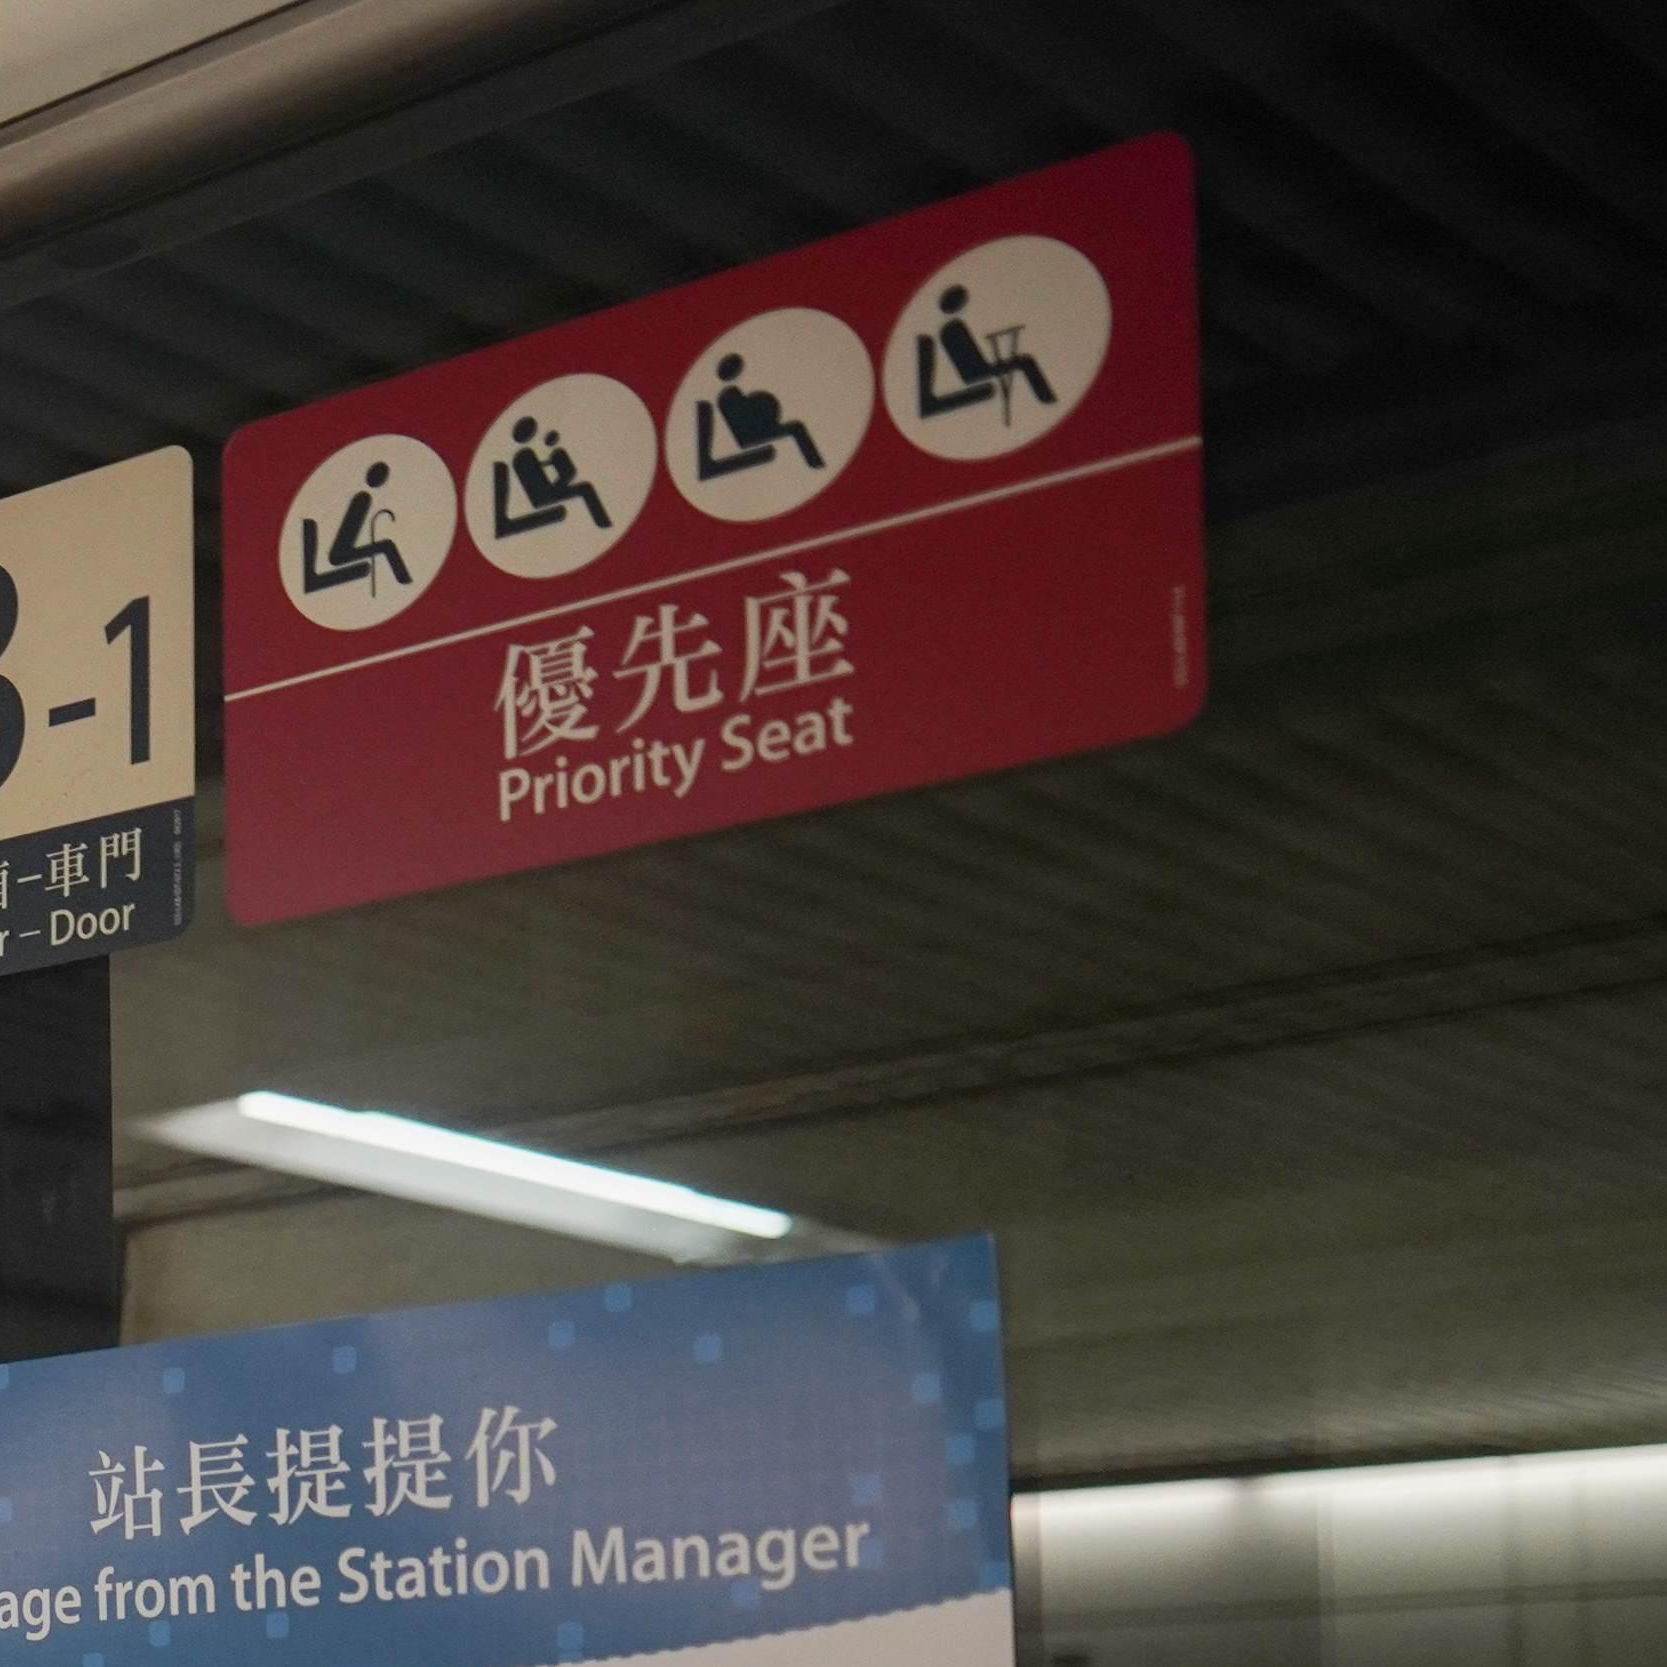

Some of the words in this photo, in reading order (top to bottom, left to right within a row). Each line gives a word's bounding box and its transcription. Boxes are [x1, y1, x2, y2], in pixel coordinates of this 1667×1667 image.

[495, 568, 855, 760] 優先座
[499, 738, 706, 822] Priority
[720, 697, 854, 772] Seat
[49, 903, 136, 946] Door
[88, 1404, 559, 1540] 站長提提你
[95, 1564, 221, 1620] from
[231, 1558, 322, 1608] the
[336, 1534, 556, 1598] Station
[571, 1520, 870, 1592] Manager
